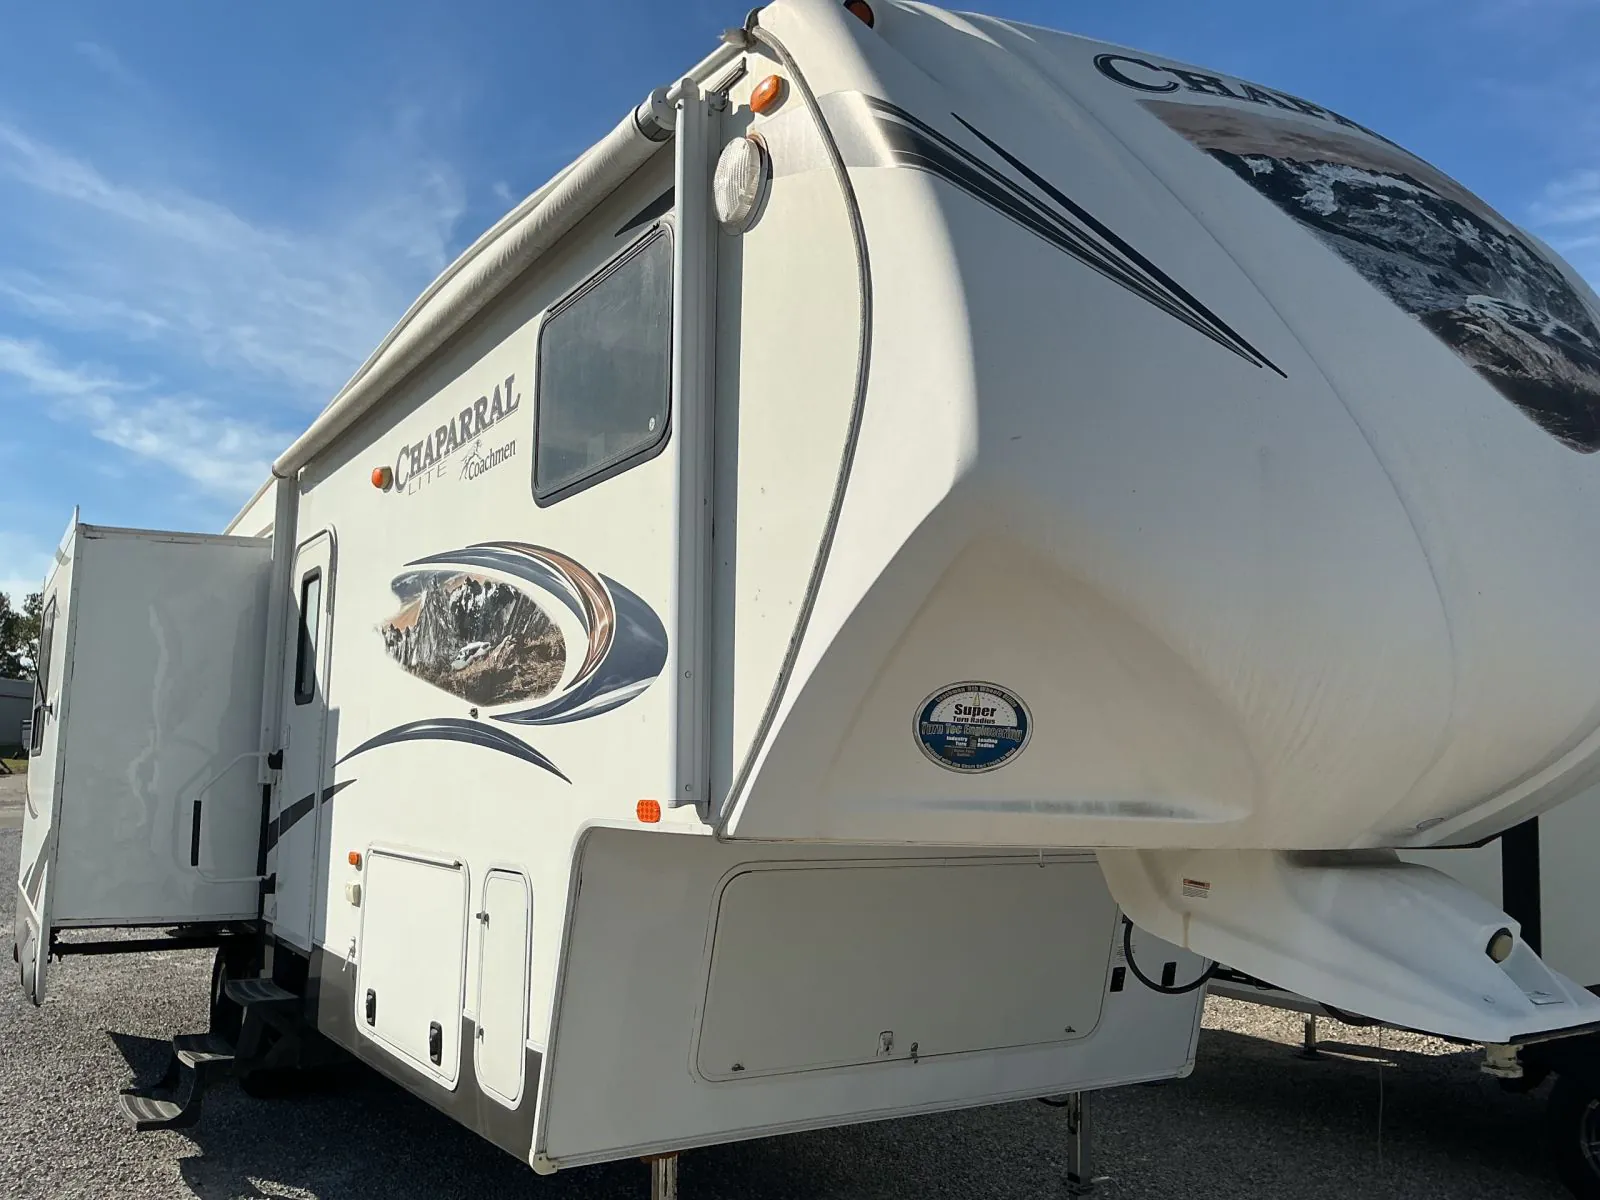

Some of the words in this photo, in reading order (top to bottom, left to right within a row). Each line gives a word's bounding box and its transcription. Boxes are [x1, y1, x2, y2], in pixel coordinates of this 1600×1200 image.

[394, 373, 521, 494] CHAPARRAL
[408, 459, 448, 496] LITE
[468, 439, 517, 481] Coachmen
[952, 716, 970, 724] Turn
[970, 716, 996, 725] Radius
[954, 703, 997, 718] Super
